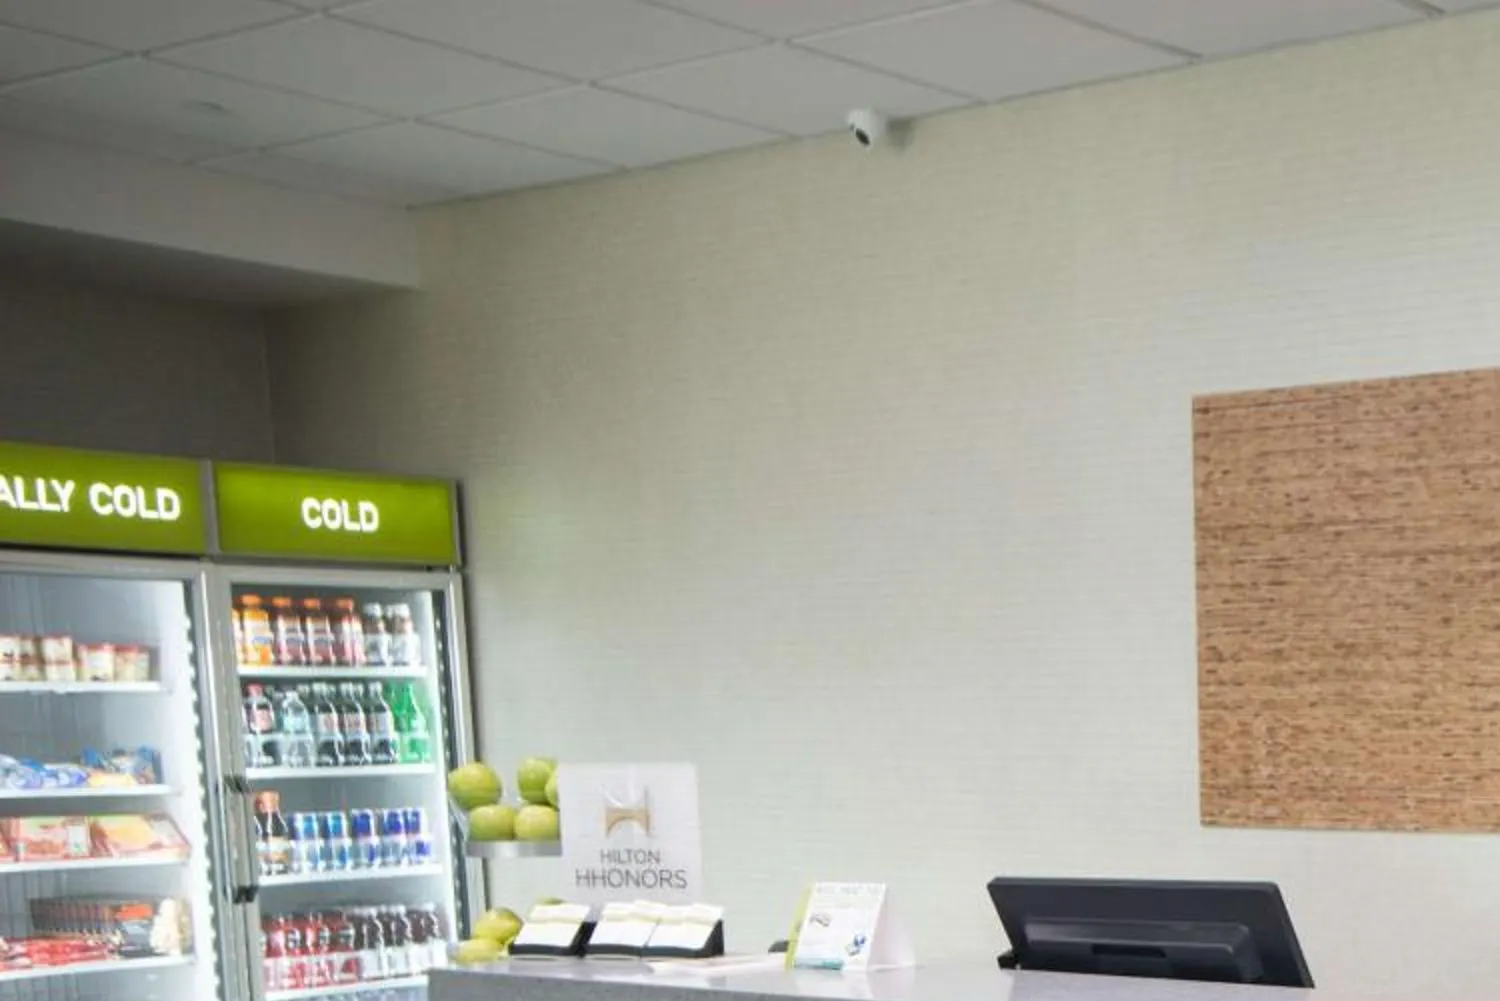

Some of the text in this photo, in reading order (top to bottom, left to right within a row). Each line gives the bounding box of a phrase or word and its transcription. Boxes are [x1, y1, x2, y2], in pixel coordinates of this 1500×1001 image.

[89, 482, 182, 521] COLD
[301, 497, 380, 533] COLD
[599, 848, 661, 865] HILTON
[575, 867, 689, 889] HHONORS
